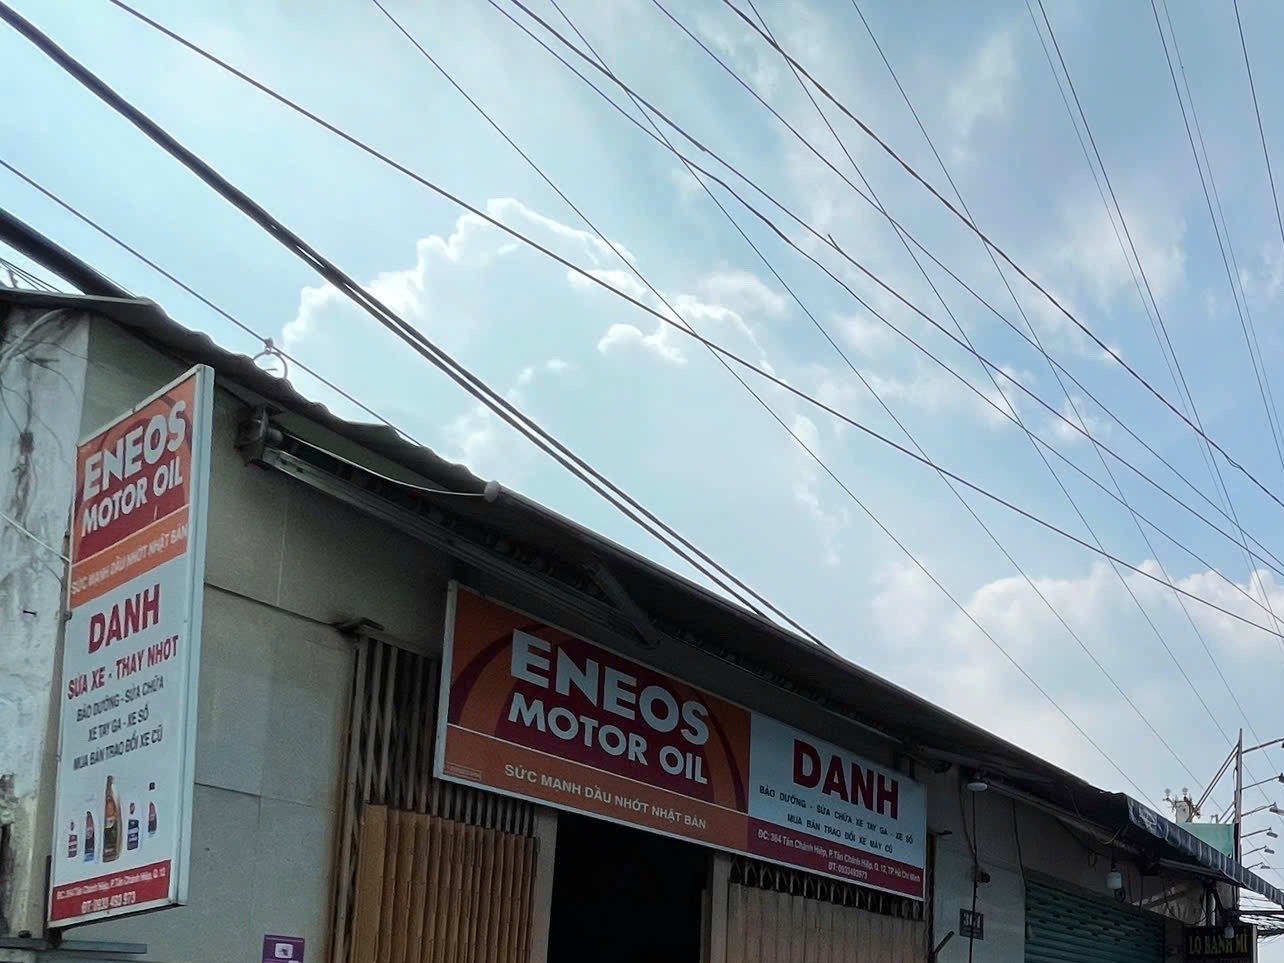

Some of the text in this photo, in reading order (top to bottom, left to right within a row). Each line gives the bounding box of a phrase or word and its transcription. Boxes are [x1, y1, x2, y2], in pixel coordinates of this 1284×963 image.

[83, 400, 187, 502] ENEOS
[81, 457, 184, 537] MOTOR OIL
[88, 584, 160, 654] DANH
[91, 666, 106, 691] XE
[116, 650, 145, 680] THAY
[511, 628, 710, 745] ENEOS
[508, 692, 708, 785] MOTOR OIL
[504, 763, 538, 783] SỨC
[541, 775, 582, 796] MẠNH
[585, 784, 612, 804] DẦU
[615, 794, 649, 814] NHỚT
[652, 804, 682, 823] NHẬT
[684, 812, 707, 830] BẢN
[793, 739, 899, 820] DANH
[787, 813, 802, 826] MUA
[824, 825, 842, 838] TRAO
[859, 835, 866, 845] XE
[856, 818, 864, 828] XE
[867, 821, 877, 831] TAY
[879, 826, 888, 835] GA
[896, 831, 903, 840] XE
